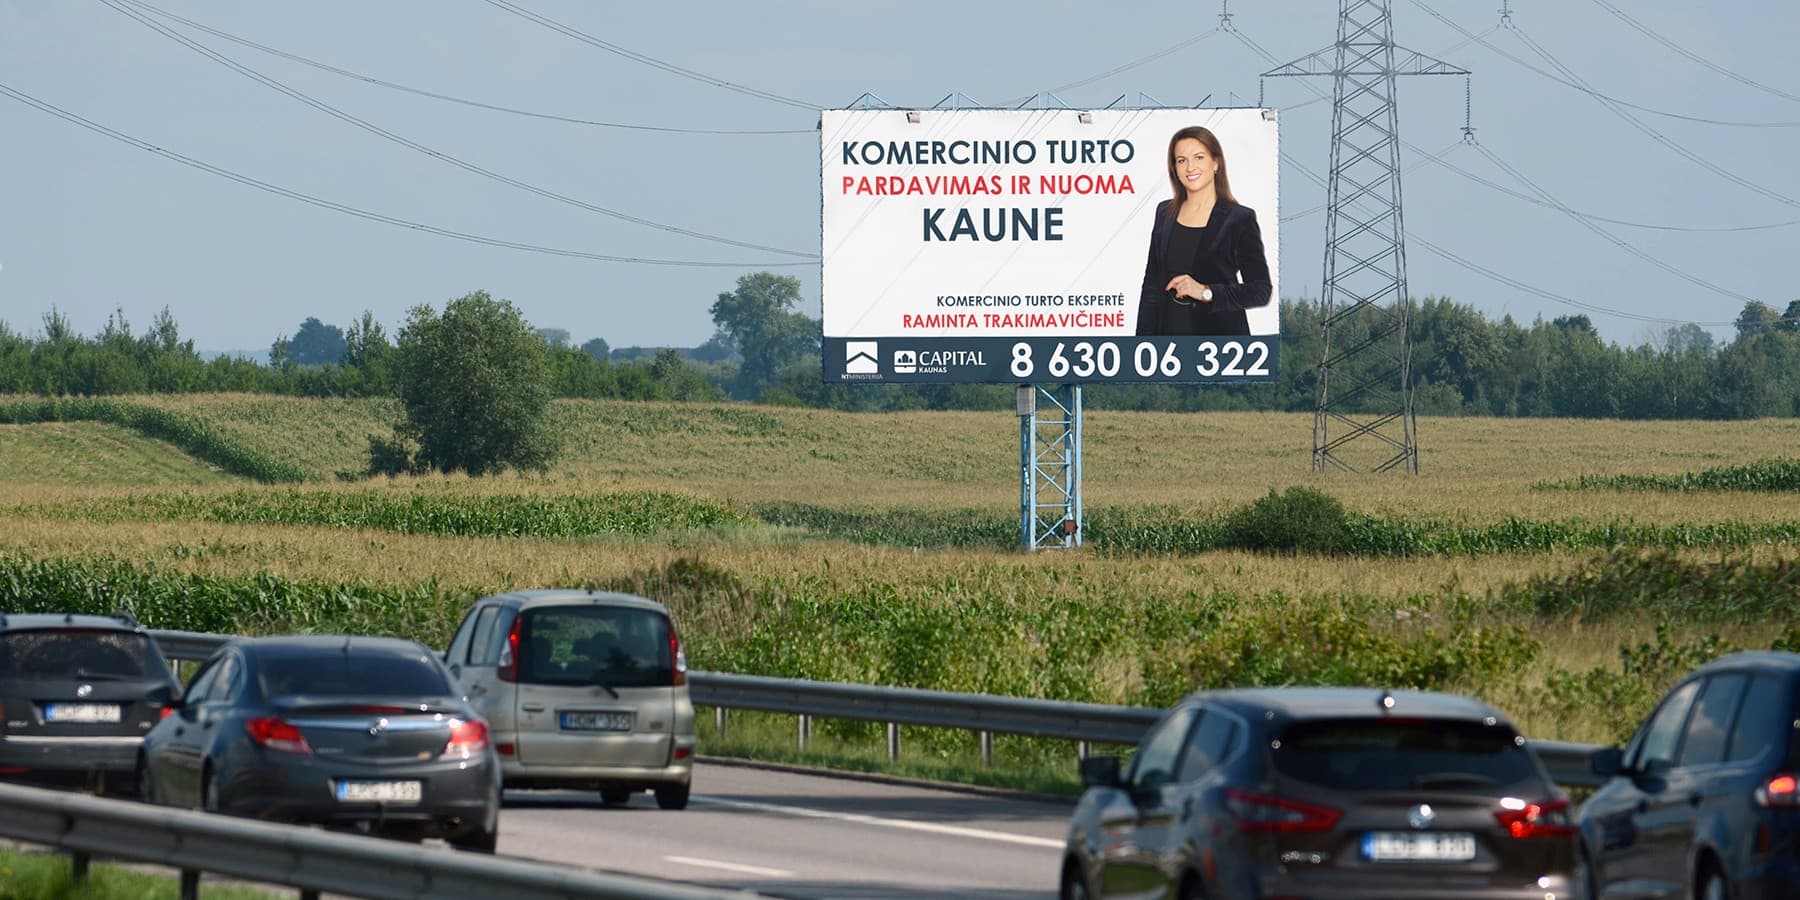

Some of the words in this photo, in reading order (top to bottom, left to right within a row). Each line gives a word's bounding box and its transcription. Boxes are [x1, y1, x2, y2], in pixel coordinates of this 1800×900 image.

[842, 140, 1037, 166] KOMERCINIO
[1046, 139, 1135, 164] TURTO
[842, 175, 1003, 196] PARDAVIMAS
[1011, 175, 1032, 195] IR
[1040, 174, 1135, 195] NUOMA
[923, 207, 1064, 242] KAUNE
[936, 295, 1022, 307] KOMERCINIO
[1025, 295, 1064, 307] TURTO
[1068, 292, 1125, 306] EKSPERTĖ
[903, 313, 979, 328] RAMINTA
[983, 310, 1125, 328] TRAKIMAVIČIENĖ
[918, 351, 987, 366] CAPITAL
[1010, 342, 1034, 378] 8
[1048, 342, 1121, 378] 630
[1134, 341, 1182, 377] 06
[1196, 341, 1270, 377] 322
[918, 366, 948, 374] KAUNAS
